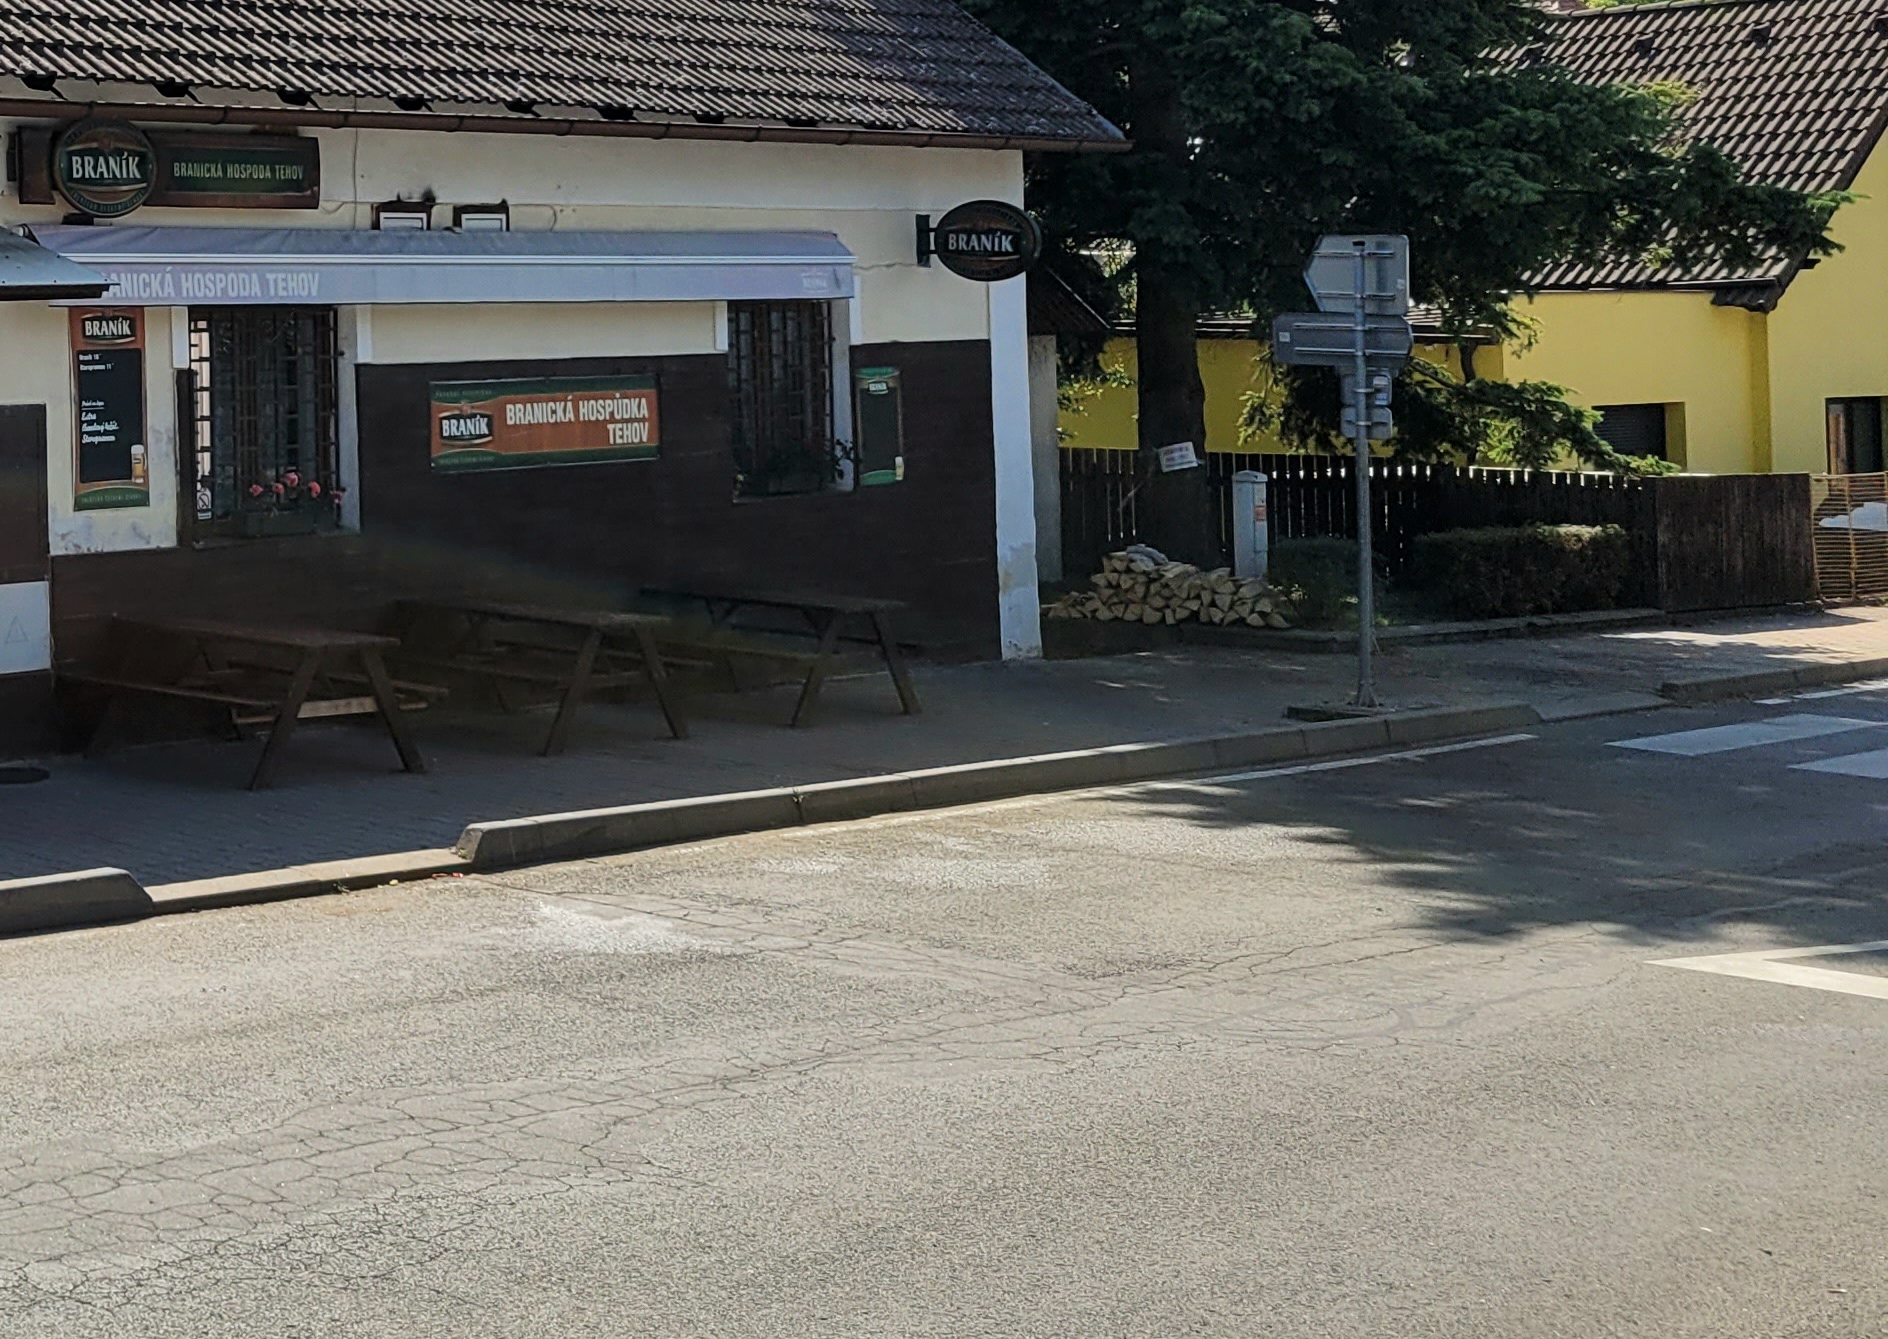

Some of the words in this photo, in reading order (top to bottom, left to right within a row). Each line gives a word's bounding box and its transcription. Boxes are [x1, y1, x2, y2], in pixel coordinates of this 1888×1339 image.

[72, 151, 141, 179] BRANÍK
[173, 160, 223, 178] BRANICKÁ
[227, 163, 272, 180] HOSPODA
[275, 164, 304, 180] TEHOV
[948, 231, 1014, 252] BRANÍK
[104, 266, 176, 298] ANICKÁ
[181, 271, 262, 298] HOSPODA
[266, 271, 319, 298] TEHOV
[85, 317, 132, 336] BRANÍK
[506, 395, 575, 425] BRANICKÁ
[579, 393, 649, 421] HOSPŮDKA
[442, 414, 489, 437] BRANÍK
[607, 422, 649, 445] TEHOV
